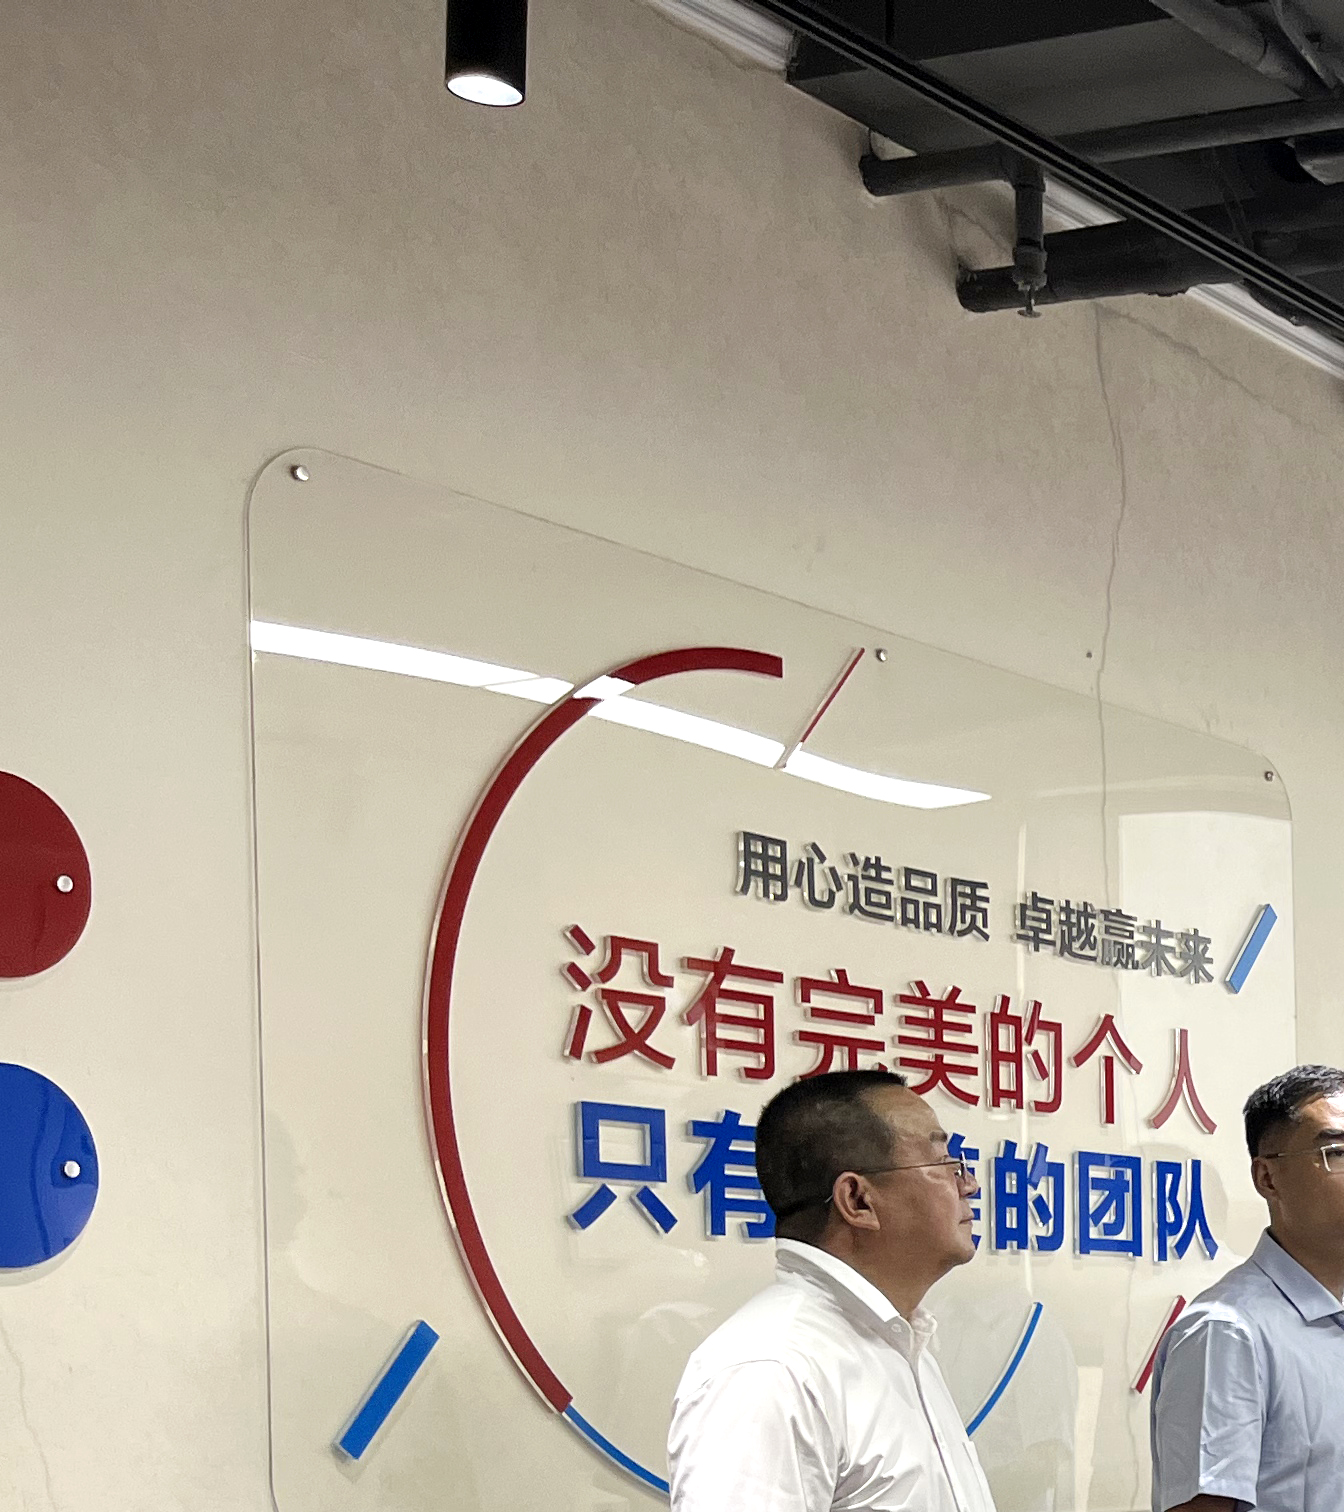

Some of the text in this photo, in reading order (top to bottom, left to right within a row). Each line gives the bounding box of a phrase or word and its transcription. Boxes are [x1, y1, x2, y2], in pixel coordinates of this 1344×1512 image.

[738, 831, 1214, 984] 用心造品质 卓越赢未来
[565, 926, 1215, 1134] 没有完美的个人
[569, 1101, 1219, 1262] 只有的团队
